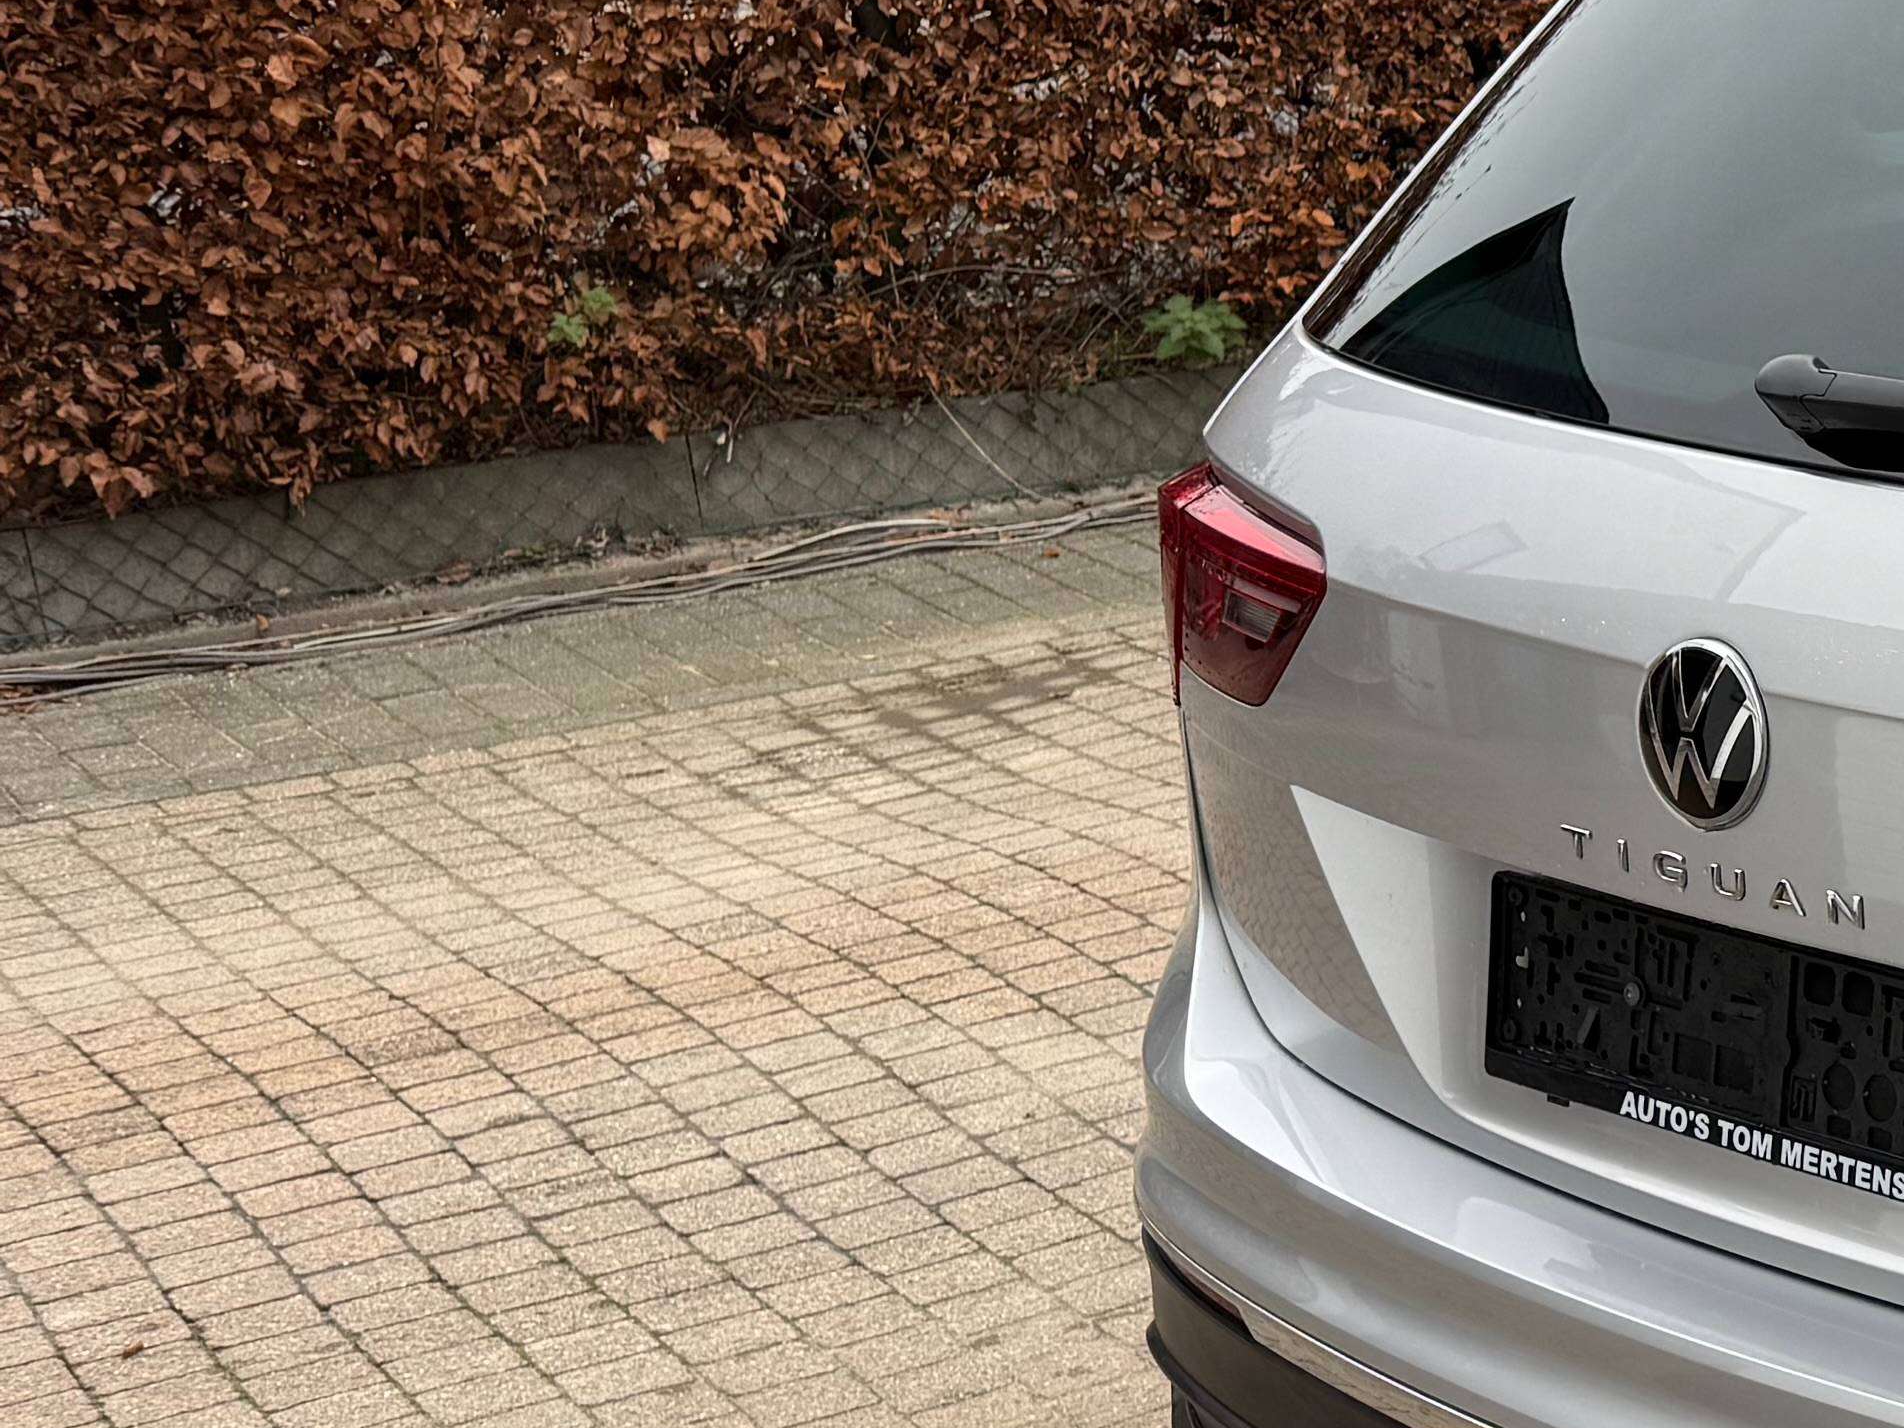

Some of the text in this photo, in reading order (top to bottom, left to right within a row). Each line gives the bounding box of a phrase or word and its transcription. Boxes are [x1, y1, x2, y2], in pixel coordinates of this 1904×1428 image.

[1560, 822, 1868, 931] TIGUAN
[1619, 1090, 1710, 1142] AUTO'S
[1717, 1118, 1774, 1161] TOM
